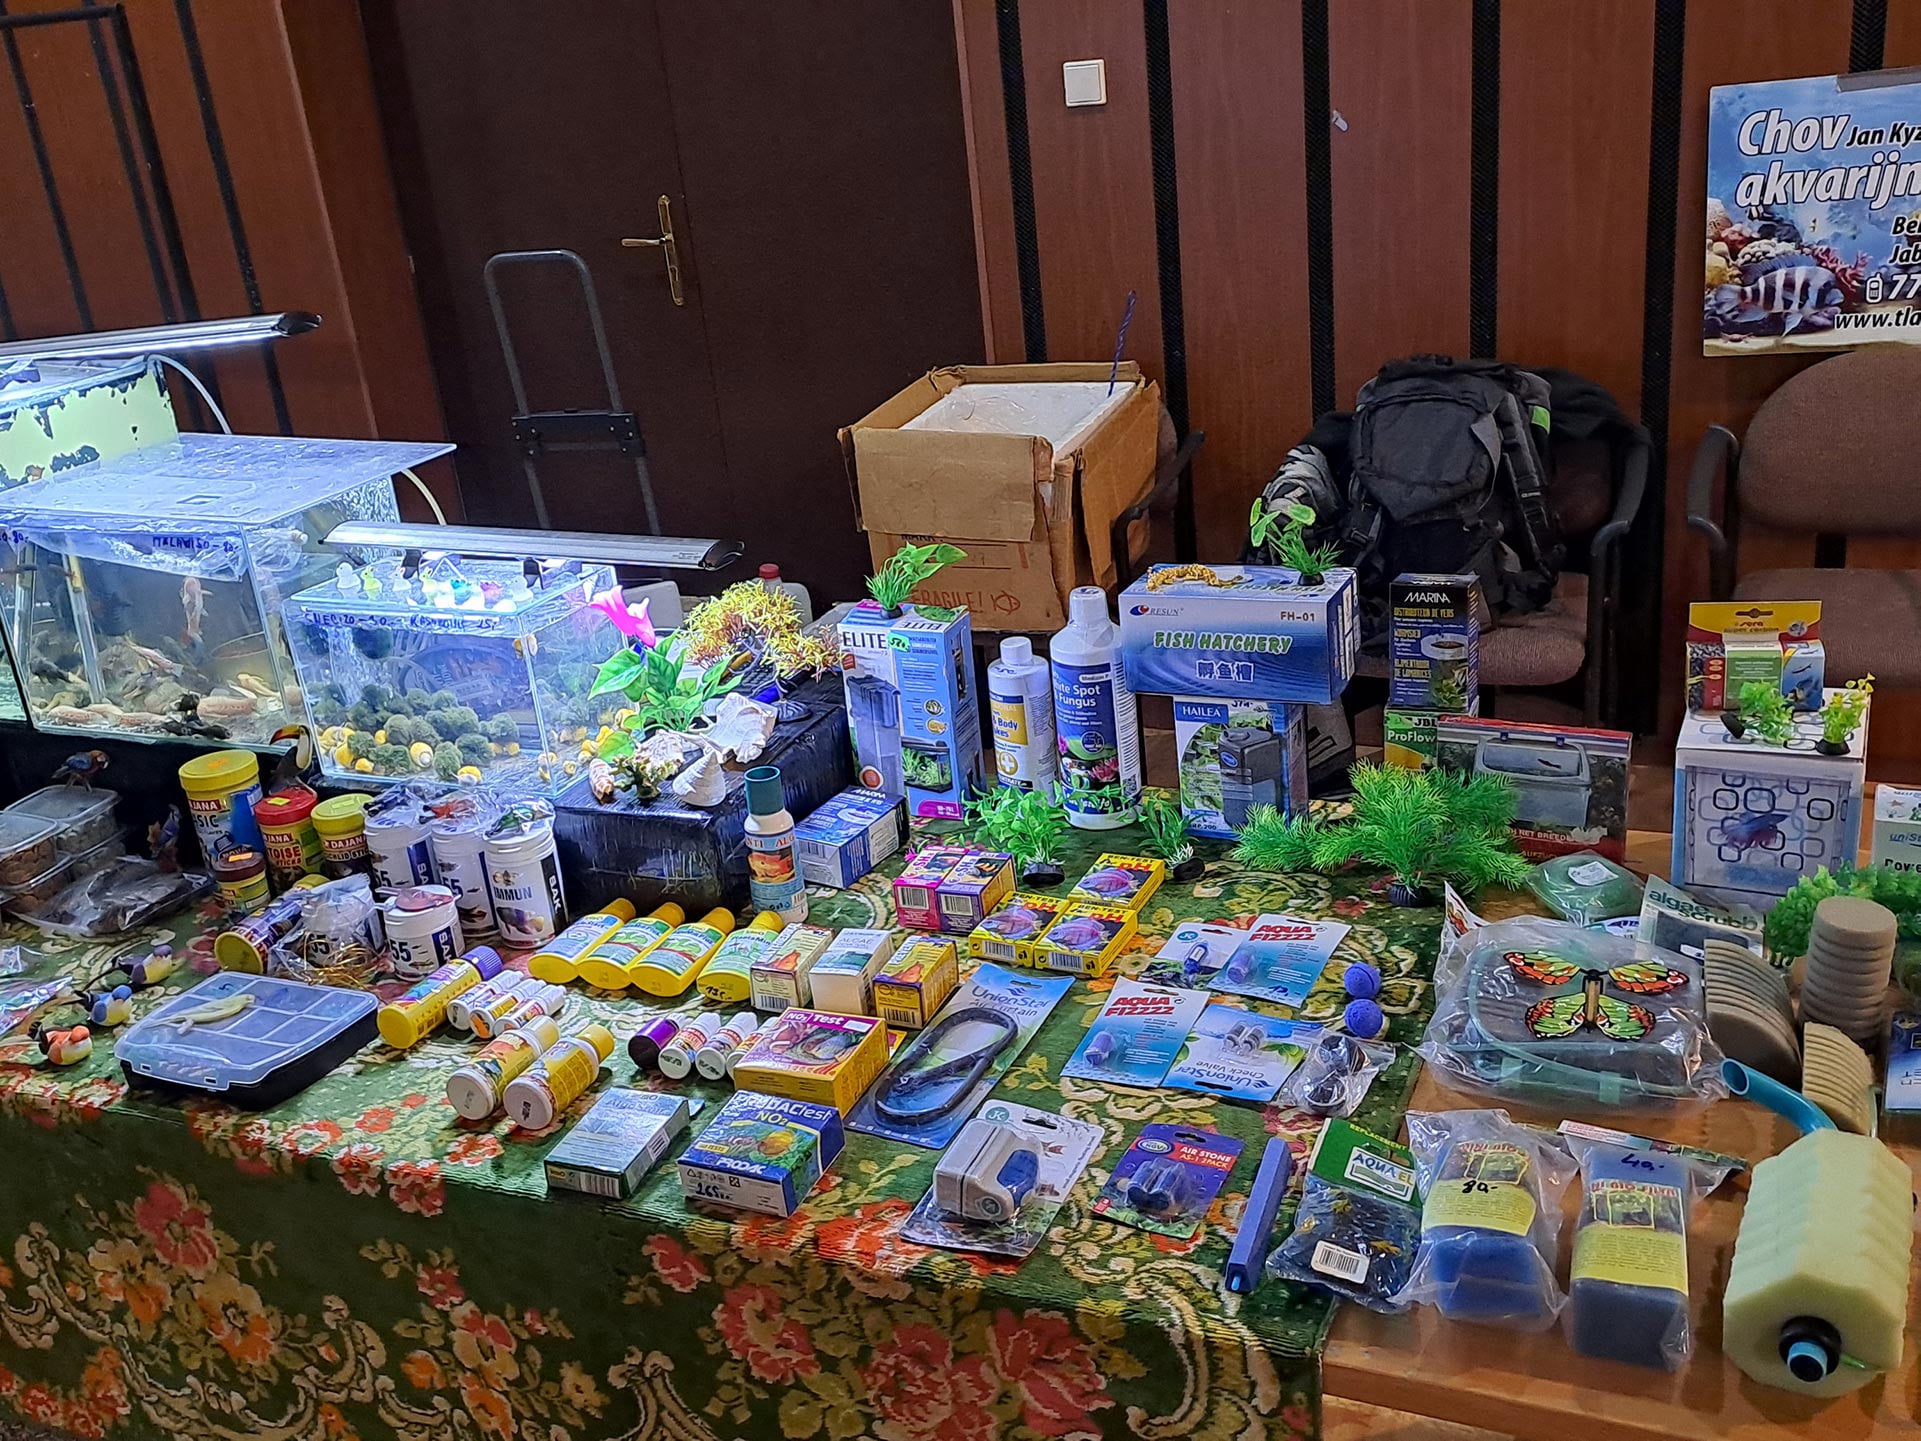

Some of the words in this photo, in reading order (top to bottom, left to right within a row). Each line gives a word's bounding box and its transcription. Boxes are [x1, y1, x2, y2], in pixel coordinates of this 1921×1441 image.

[1738, 108, 1850, 156] Chov
[1847, 126, 1884, 147] Jan
[1735, 151, 1921, 210] akvarijn
[1404, 592, 1451, 603] MARINA
[1280, 611, 1316, 622] FH-01
[842, 631, 887, 649] ELITE
[1154, 632, 1196, 648] FISH
[1198, 634, 1293, 655] HATCHERY
[1073, 684, 1101, 698] Spot
[1060, 693, 1097, 709] Fungus
[1183, 706, 1221, 717] HAILEA
[998, 717, 1018, 730] Body
[1387, 730, 1436, 742] ProFlow
[190, 801, 218, 811] JANA
[264, 834, 290, 843] JANA
[418, 863, 428, 883] BA
[549, 875, 562, 914] BAK
[1649, 889, 1710, 913] algae
[1679, 909, 1758, 930] scrubb
[1256, 925, 1312, 933] AQUA
[390, 941, 412, 961] 55
[972, 985, 1050, 1008] UnionStar
[1112, 997, 1170, 1006] AQUA
[813, 1014, 845, 1025] Test
[1105, 1007, 1175, 1016] FIZZZZ
[1196, 1061, 1226, 1072] Valve
[1229, 1066, 1264, 1078] Check
[1174, 1066, 1251, 1086] UnionStar
[1350, 1123, 1408, 1150] REPLACEMENT
[1180, 1146, 1196, 1155] AIR
[1199, 1150, 1232, 1162] STONE
[716, 1158, 767, 1175] PRODAC
